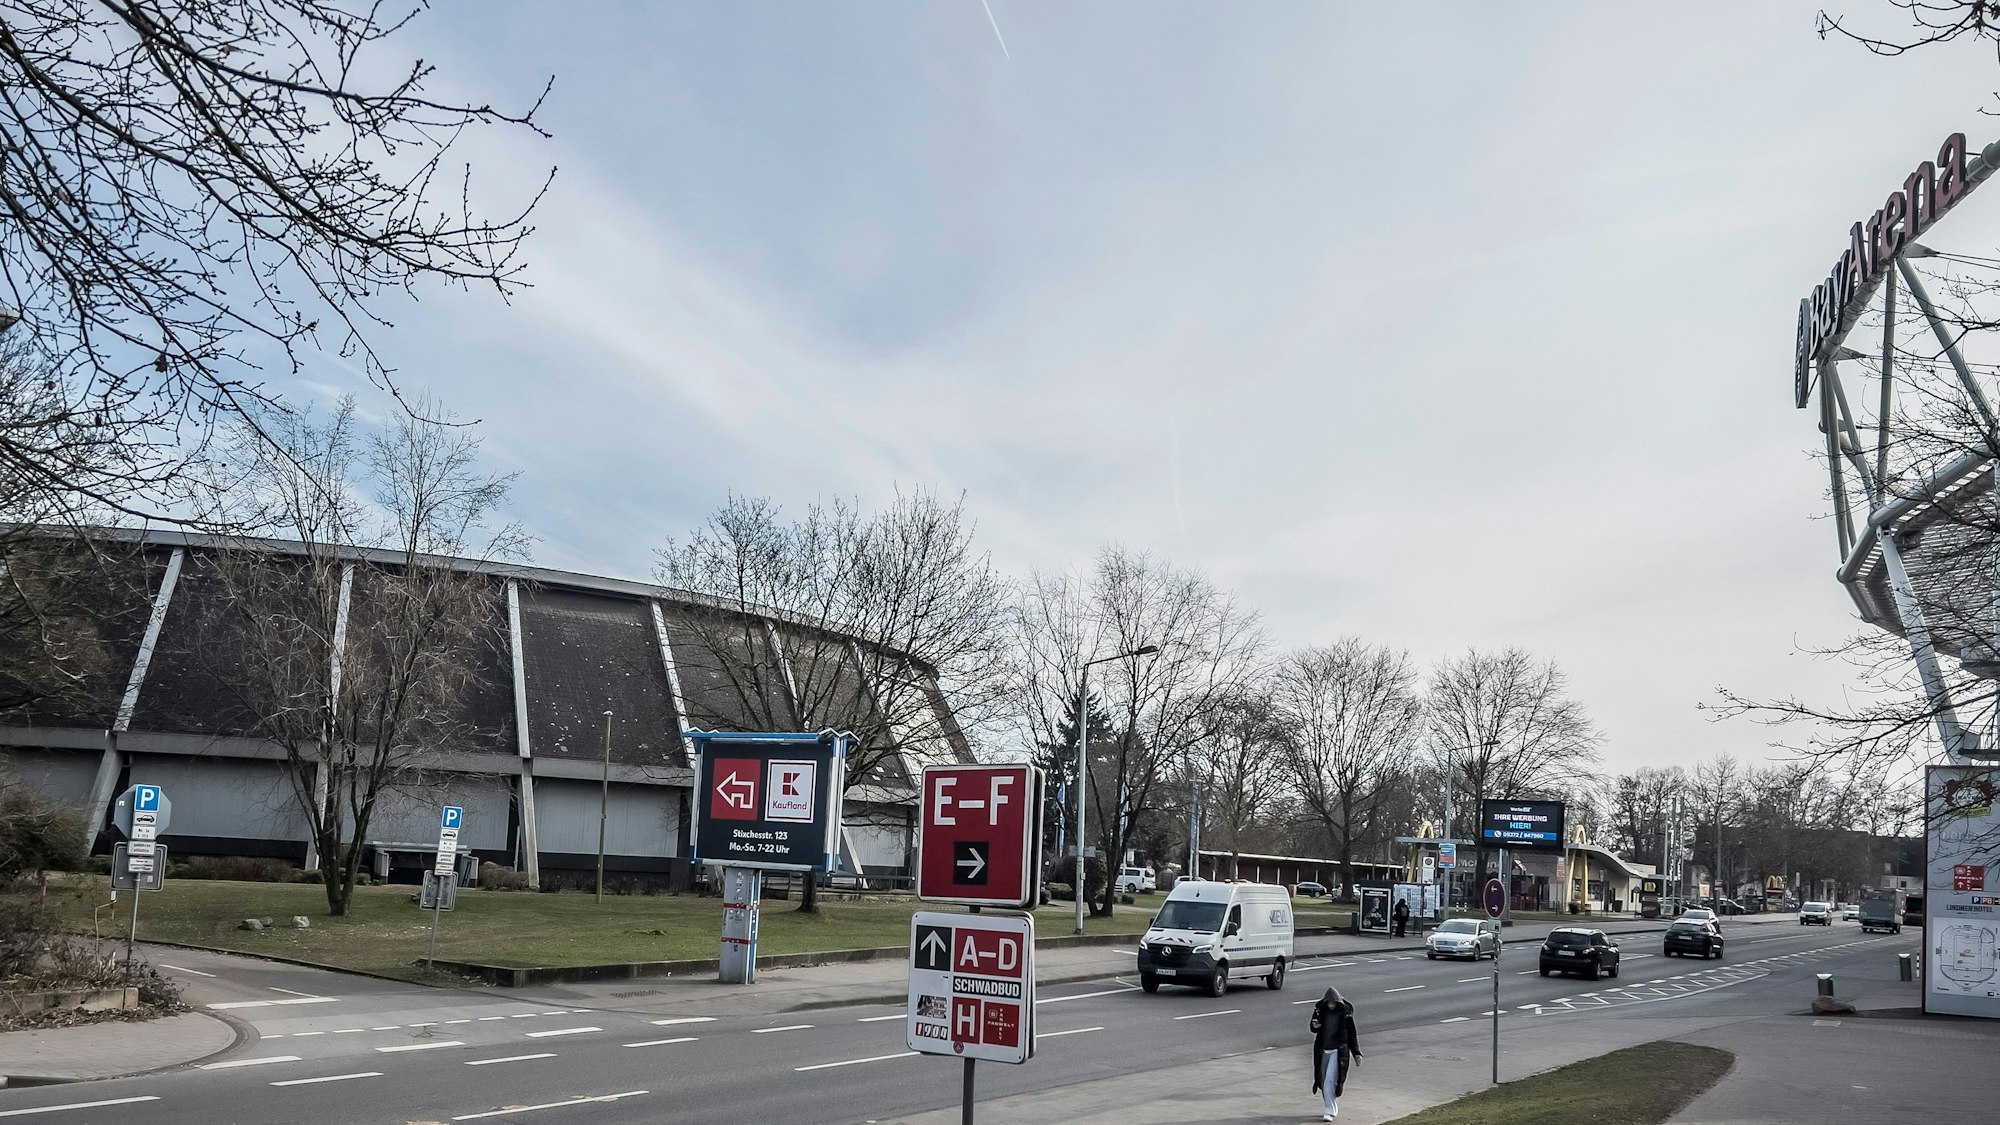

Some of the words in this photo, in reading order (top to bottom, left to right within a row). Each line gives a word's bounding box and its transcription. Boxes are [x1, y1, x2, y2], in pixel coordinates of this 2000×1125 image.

[1810, 132, 1967, 360] BayArena
[140, 788, 155, 808] P
[772, 801, 808, 810] Kaufland
[446, 809, 458, 826] P
[1512, 814, 1548, 822] WERBUNG
[733, 829, 773, 839] Stixchesstr.
[775, 831, 788, 840] 123
[729, 842, 756, 852] Mo.-Sa.
[757, 843, 775, 853] 7-22
[776, 845, 790, 854] Uhr
[960, 935, 1018, 971] A-D
[954, 979, 1020, 997] SCHWADBUD
[956, 1003, 976, 1037] H
